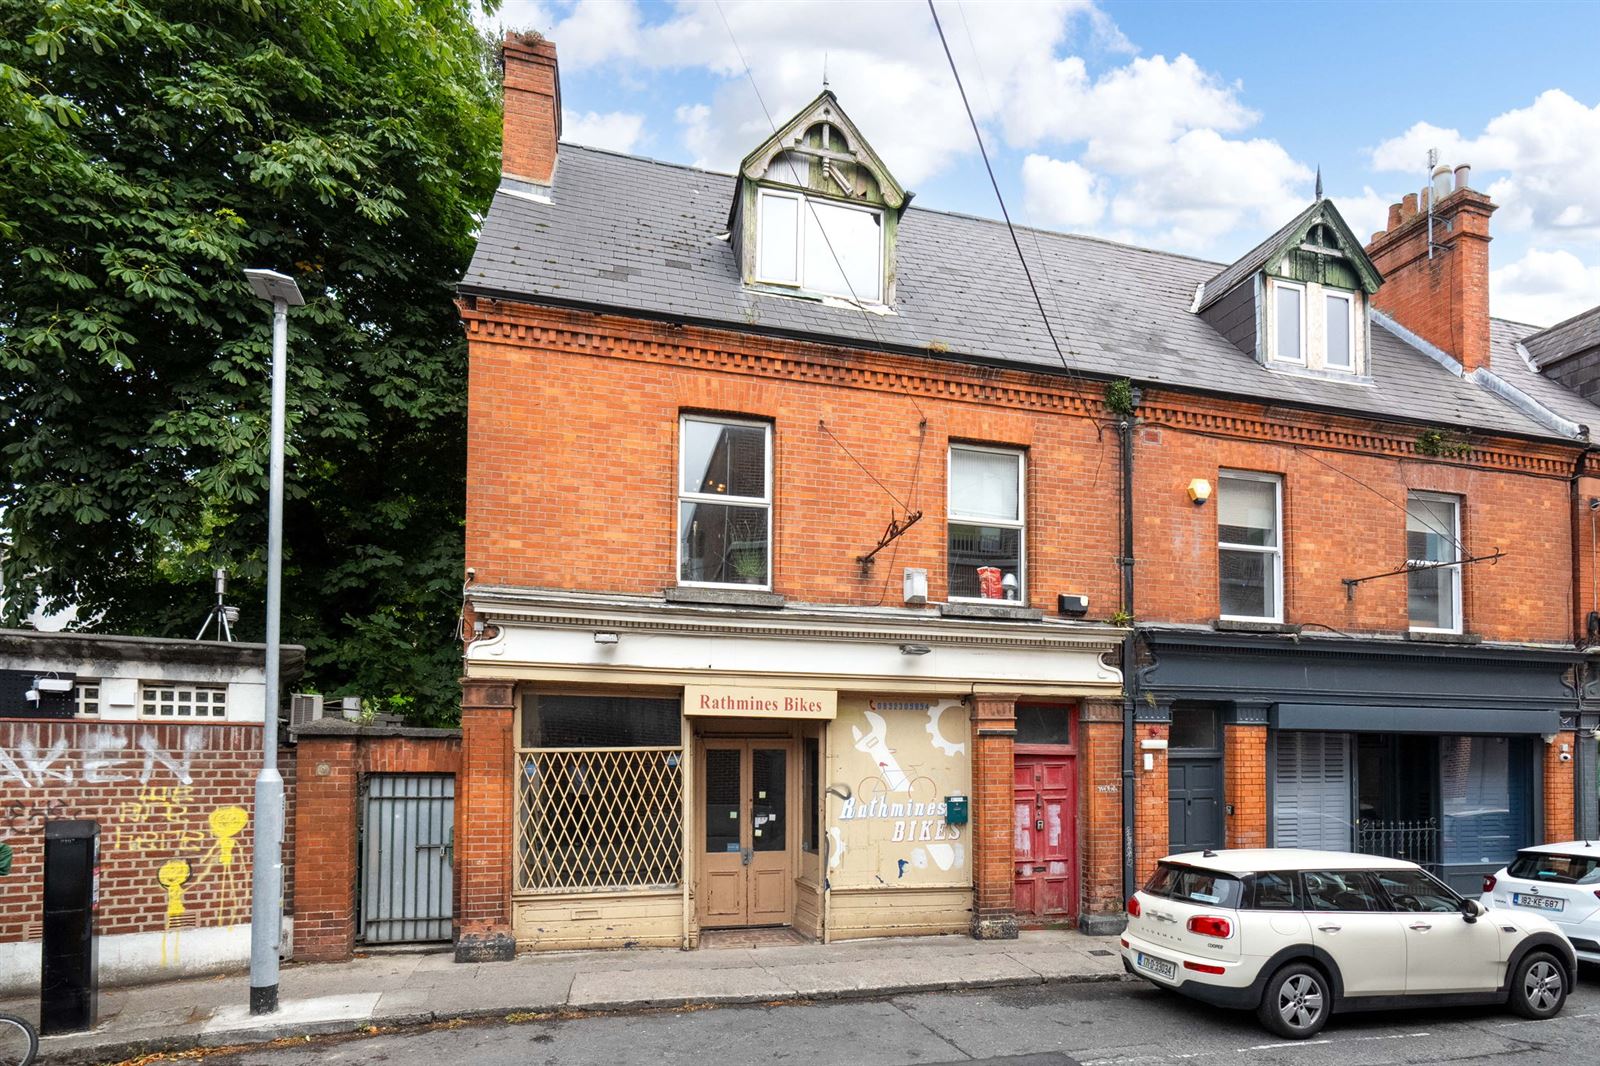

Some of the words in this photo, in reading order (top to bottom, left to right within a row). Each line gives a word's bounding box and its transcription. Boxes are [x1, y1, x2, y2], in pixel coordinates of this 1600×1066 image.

[700, 694, 778, 711] Rathmines
[784, 697, 822, 712] Bikes
[839, 794, 948, 820] Rathmines
[891, 820, 961, 842] BIKES
[1520, 896, 1559, 909] 182-KE-687
